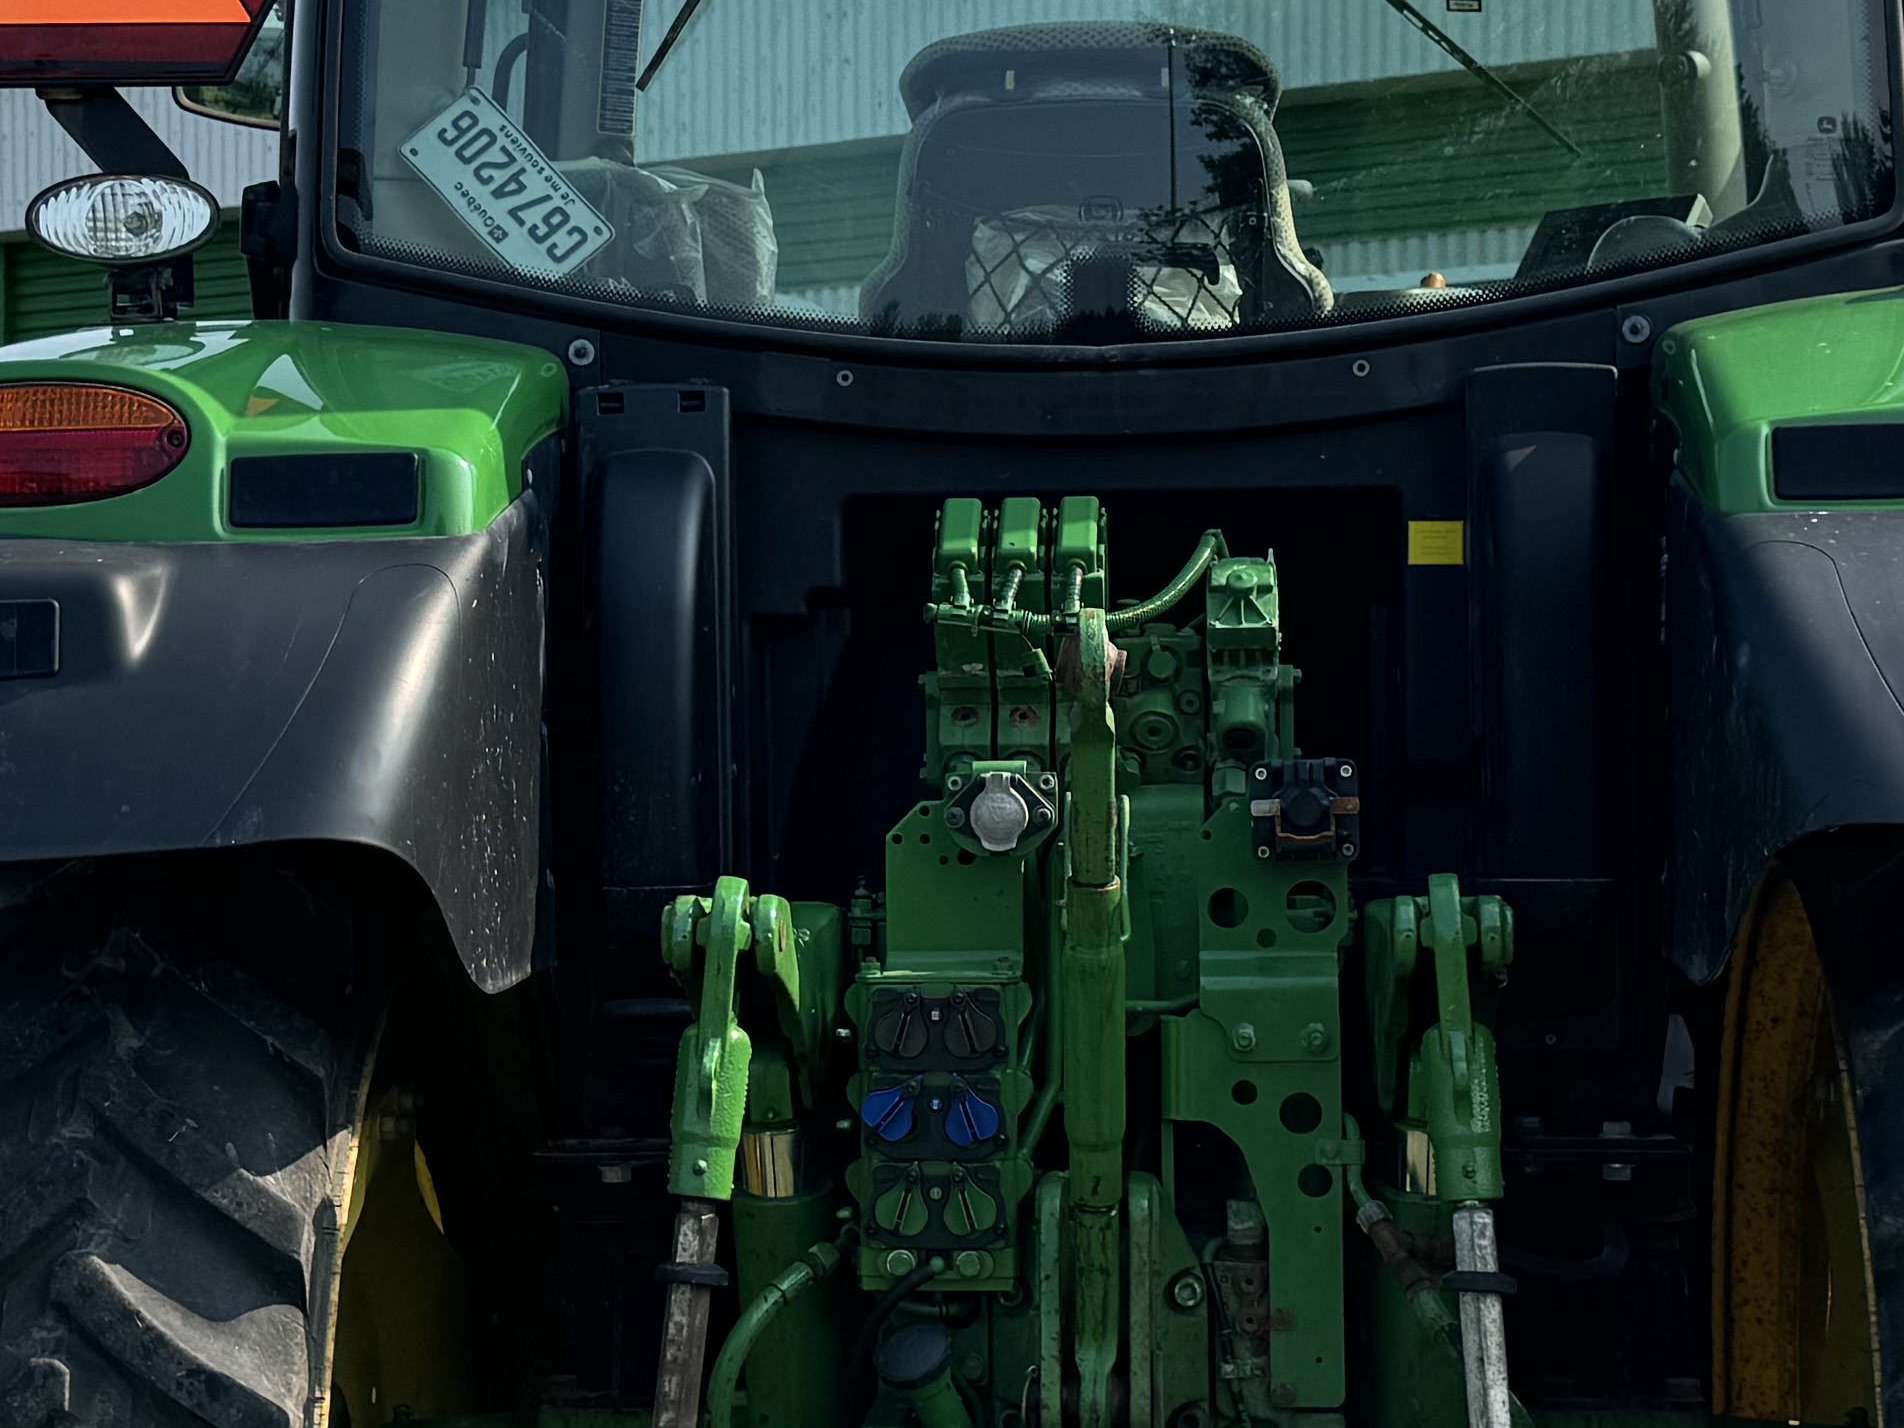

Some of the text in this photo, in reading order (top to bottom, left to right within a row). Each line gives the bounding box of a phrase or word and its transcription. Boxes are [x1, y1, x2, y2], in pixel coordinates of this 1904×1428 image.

[437, 109, 588, 264] C674206
[453, 181, 495, 228] Québec
[499, 124, 576, 206] Je me souviens
